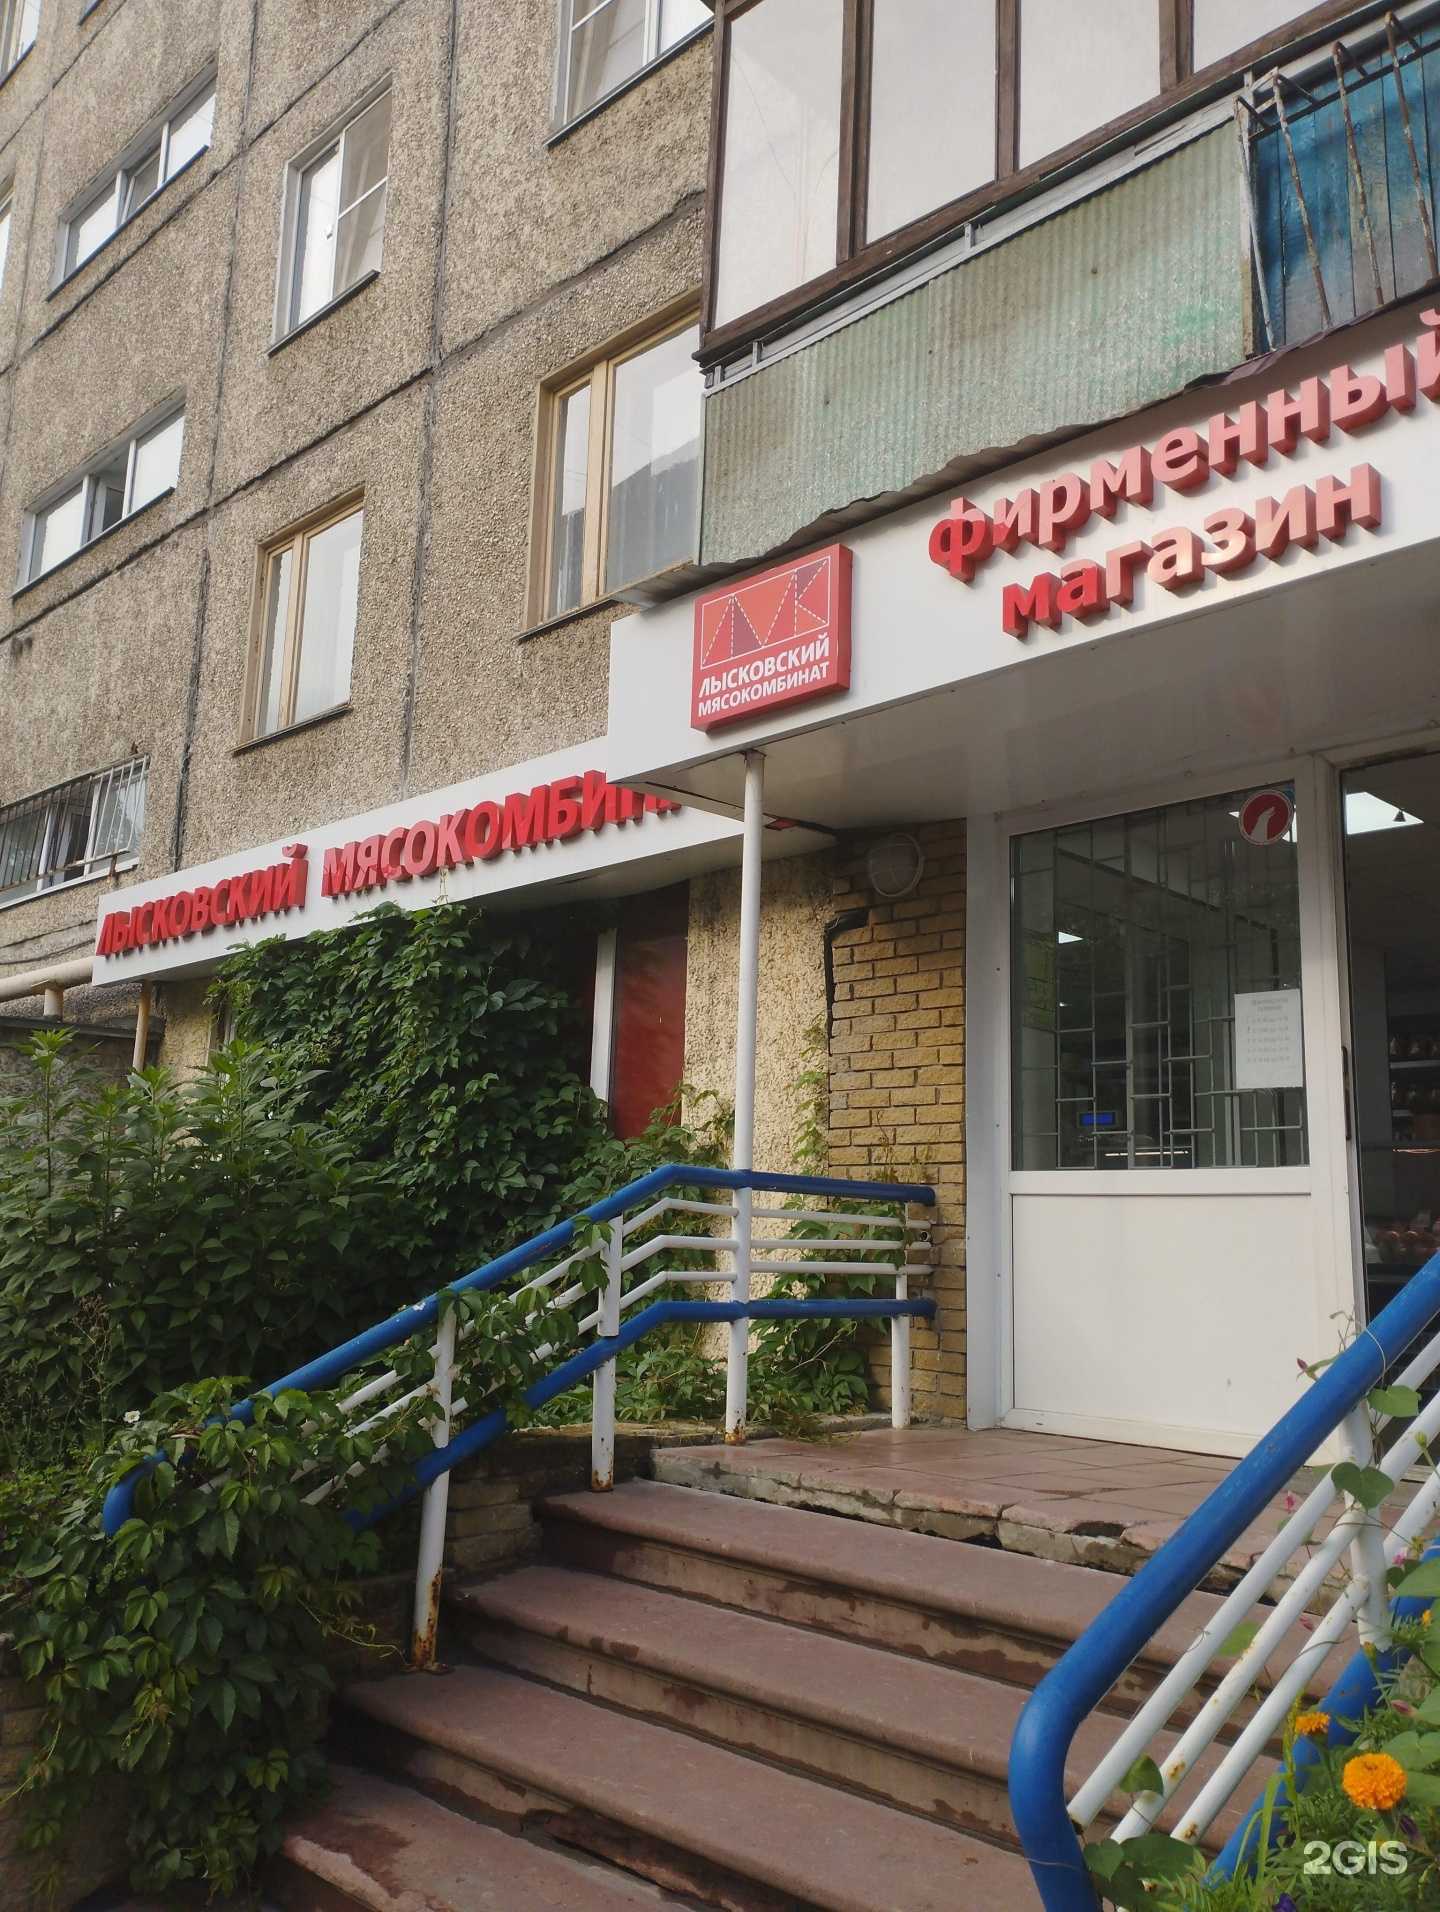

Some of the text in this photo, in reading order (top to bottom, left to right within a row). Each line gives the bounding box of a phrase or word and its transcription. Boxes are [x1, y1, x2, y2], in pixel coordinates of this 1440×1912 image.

[1002, 463, 1382, 639] магазин
[697, 661, 830, 717] МЯСОКОМБИНАТ
[698, 633, 830, 698] ЛЫСКОВСКИЙ
[96, 770, 681, 956] ЛЫСКОВСКИЙ МЯСОКОМБИ
